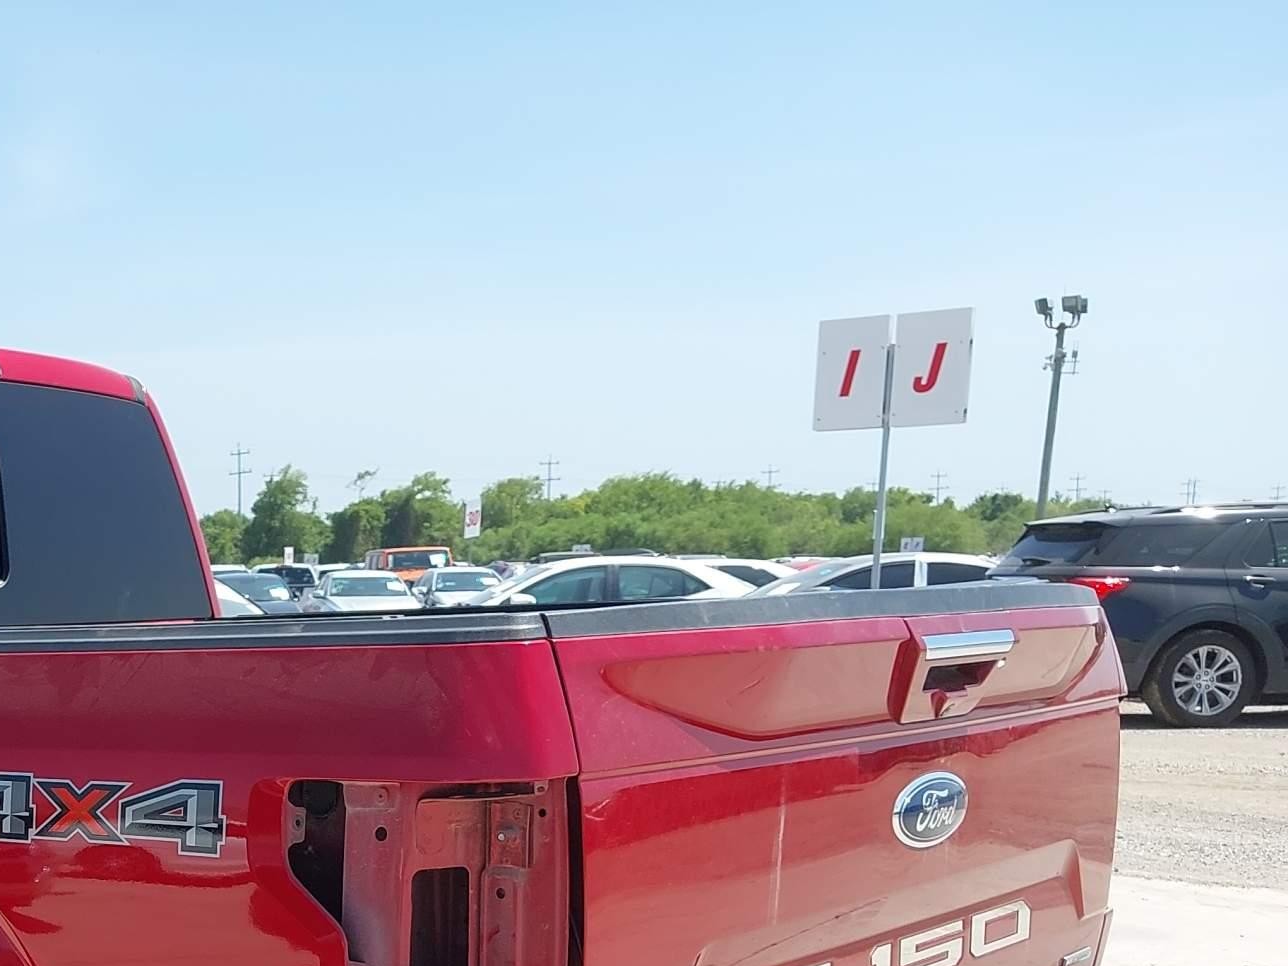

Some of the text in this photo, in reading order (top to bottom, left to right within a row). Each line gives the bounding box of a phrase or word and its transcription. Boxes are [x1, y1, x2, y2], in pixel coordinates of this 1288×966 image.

[839, 349, 861, 397] I
[913, 342, 948, 393] J
[916, 789, 958, 832] Ford
